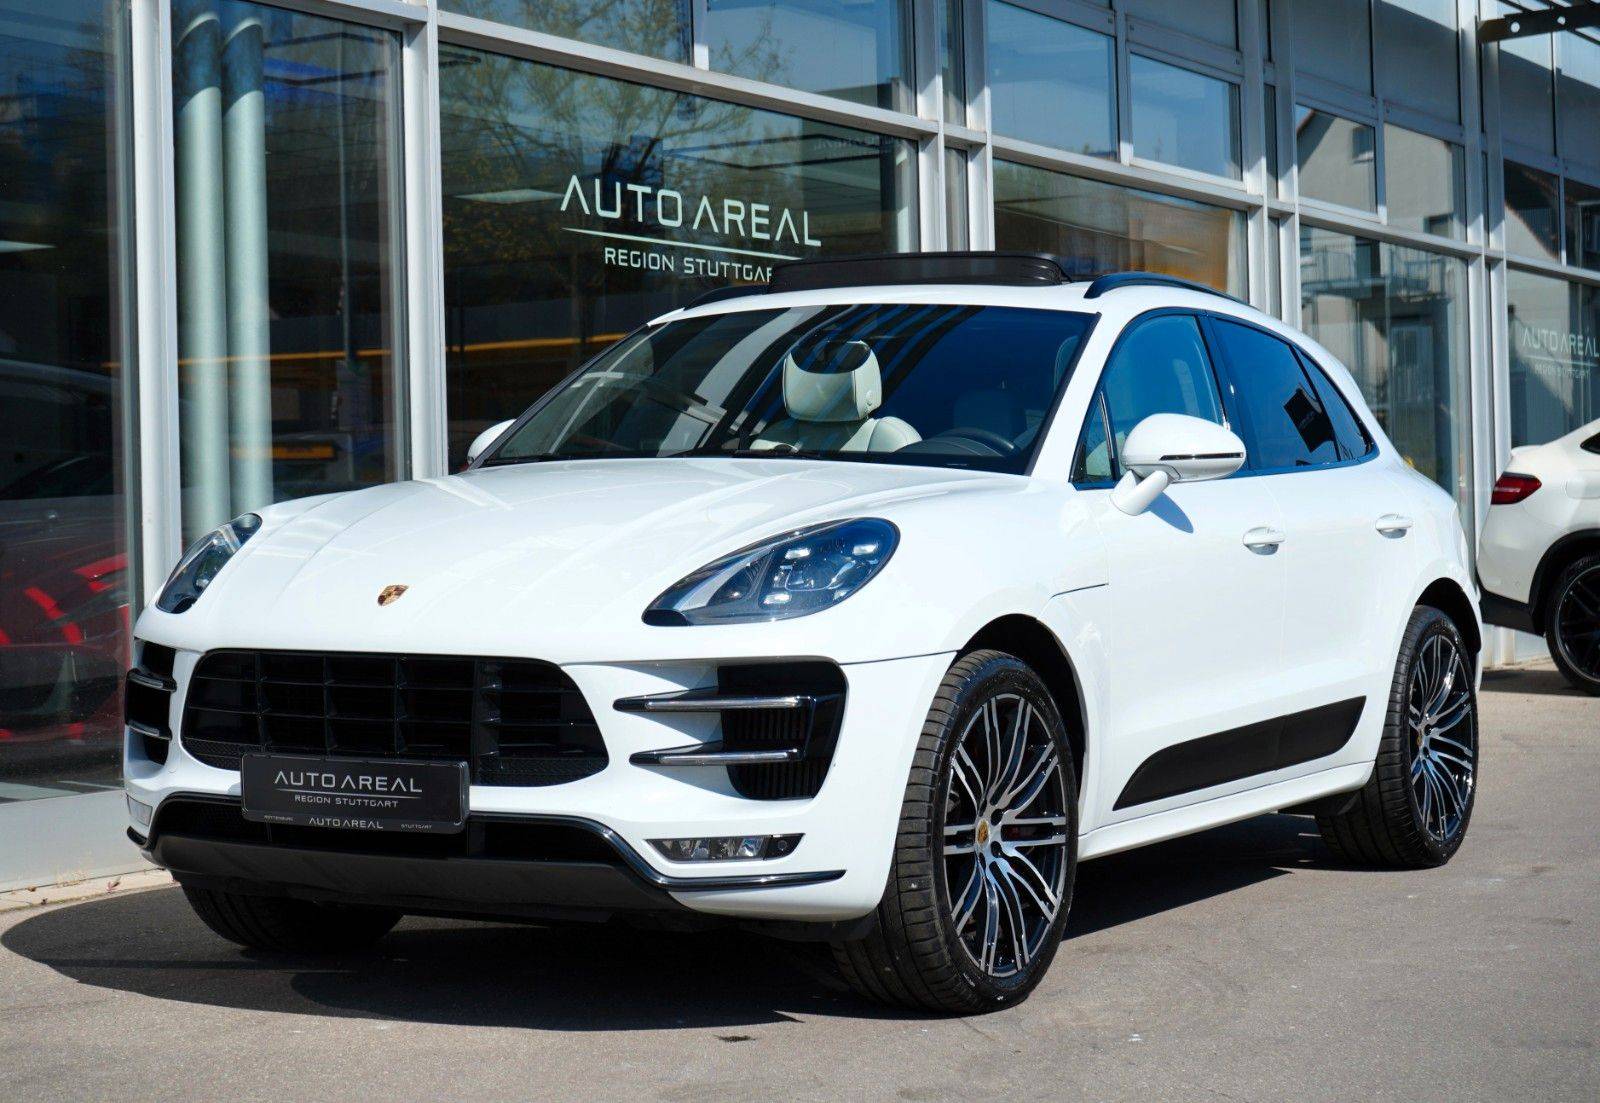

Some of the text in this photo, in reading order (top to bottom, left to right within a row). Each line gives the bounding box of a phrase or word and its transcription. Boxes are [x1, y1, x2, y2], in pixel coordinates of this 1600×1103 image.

[604, 247, 675, 272] REGION
[294, 795, 399, 808] REGION STUTTGART
